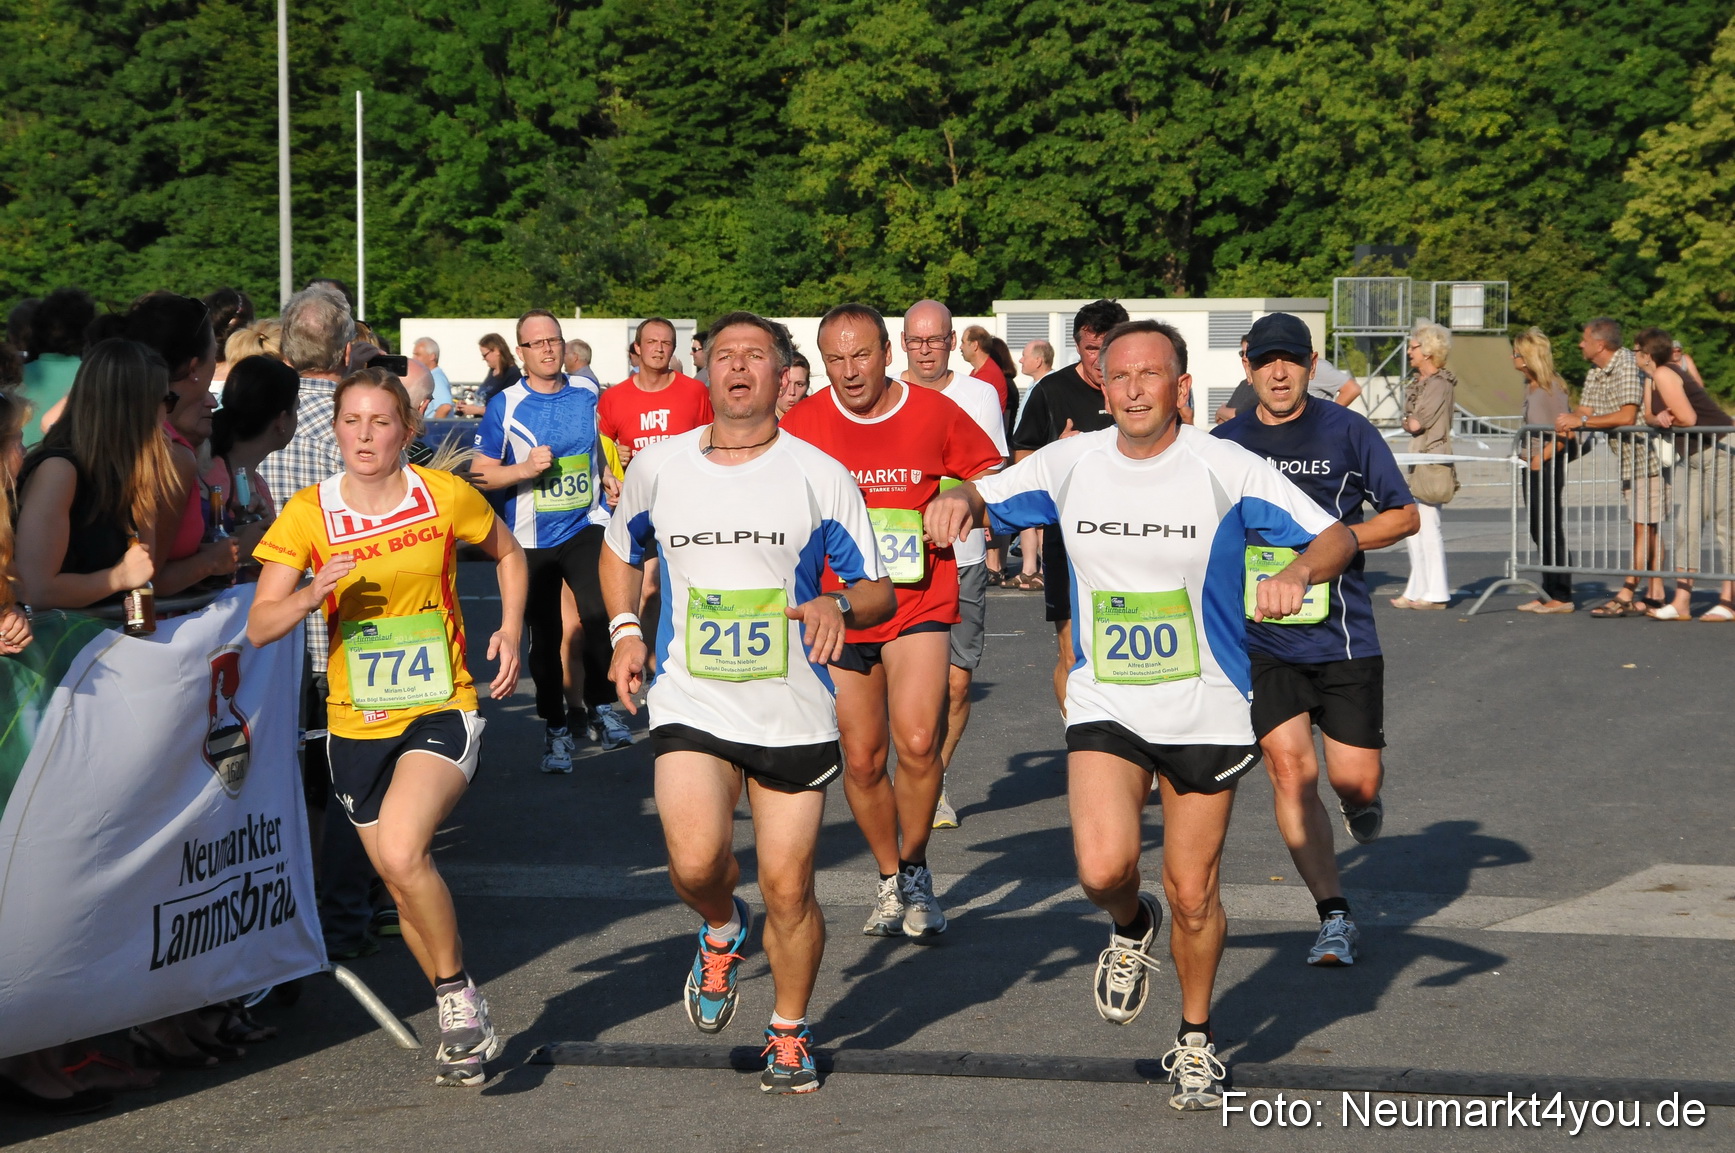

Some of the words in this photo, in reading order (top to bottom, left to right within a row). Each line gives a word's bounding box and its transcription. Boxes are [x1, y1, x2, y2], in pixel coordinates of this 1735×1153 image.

[640, 408, 670, 432] MRT
[850, 468, 907, 484] MARKT
[1280, 459, 1331, 475] POLES
[540, 473, 589, 499] 1036
[670, 531, 785, 548] DELPHI
[1076, 520, 1197, 539] DELPHI
[331, 543, 382, 562] AX
[388, 525, 444, 552] BÖGL
[701, 602, 735, 612] firmenlauf
[1105, 605, 1139, 615] firmenlauf
[357, 632, 393, 643] firmenlauf
[699, 620, 771, 657] 215
[1105, 623, 1178, 661] 200
[358, 646, 434, 687] 774
[179, 812, 281, 887] Neumarkter
